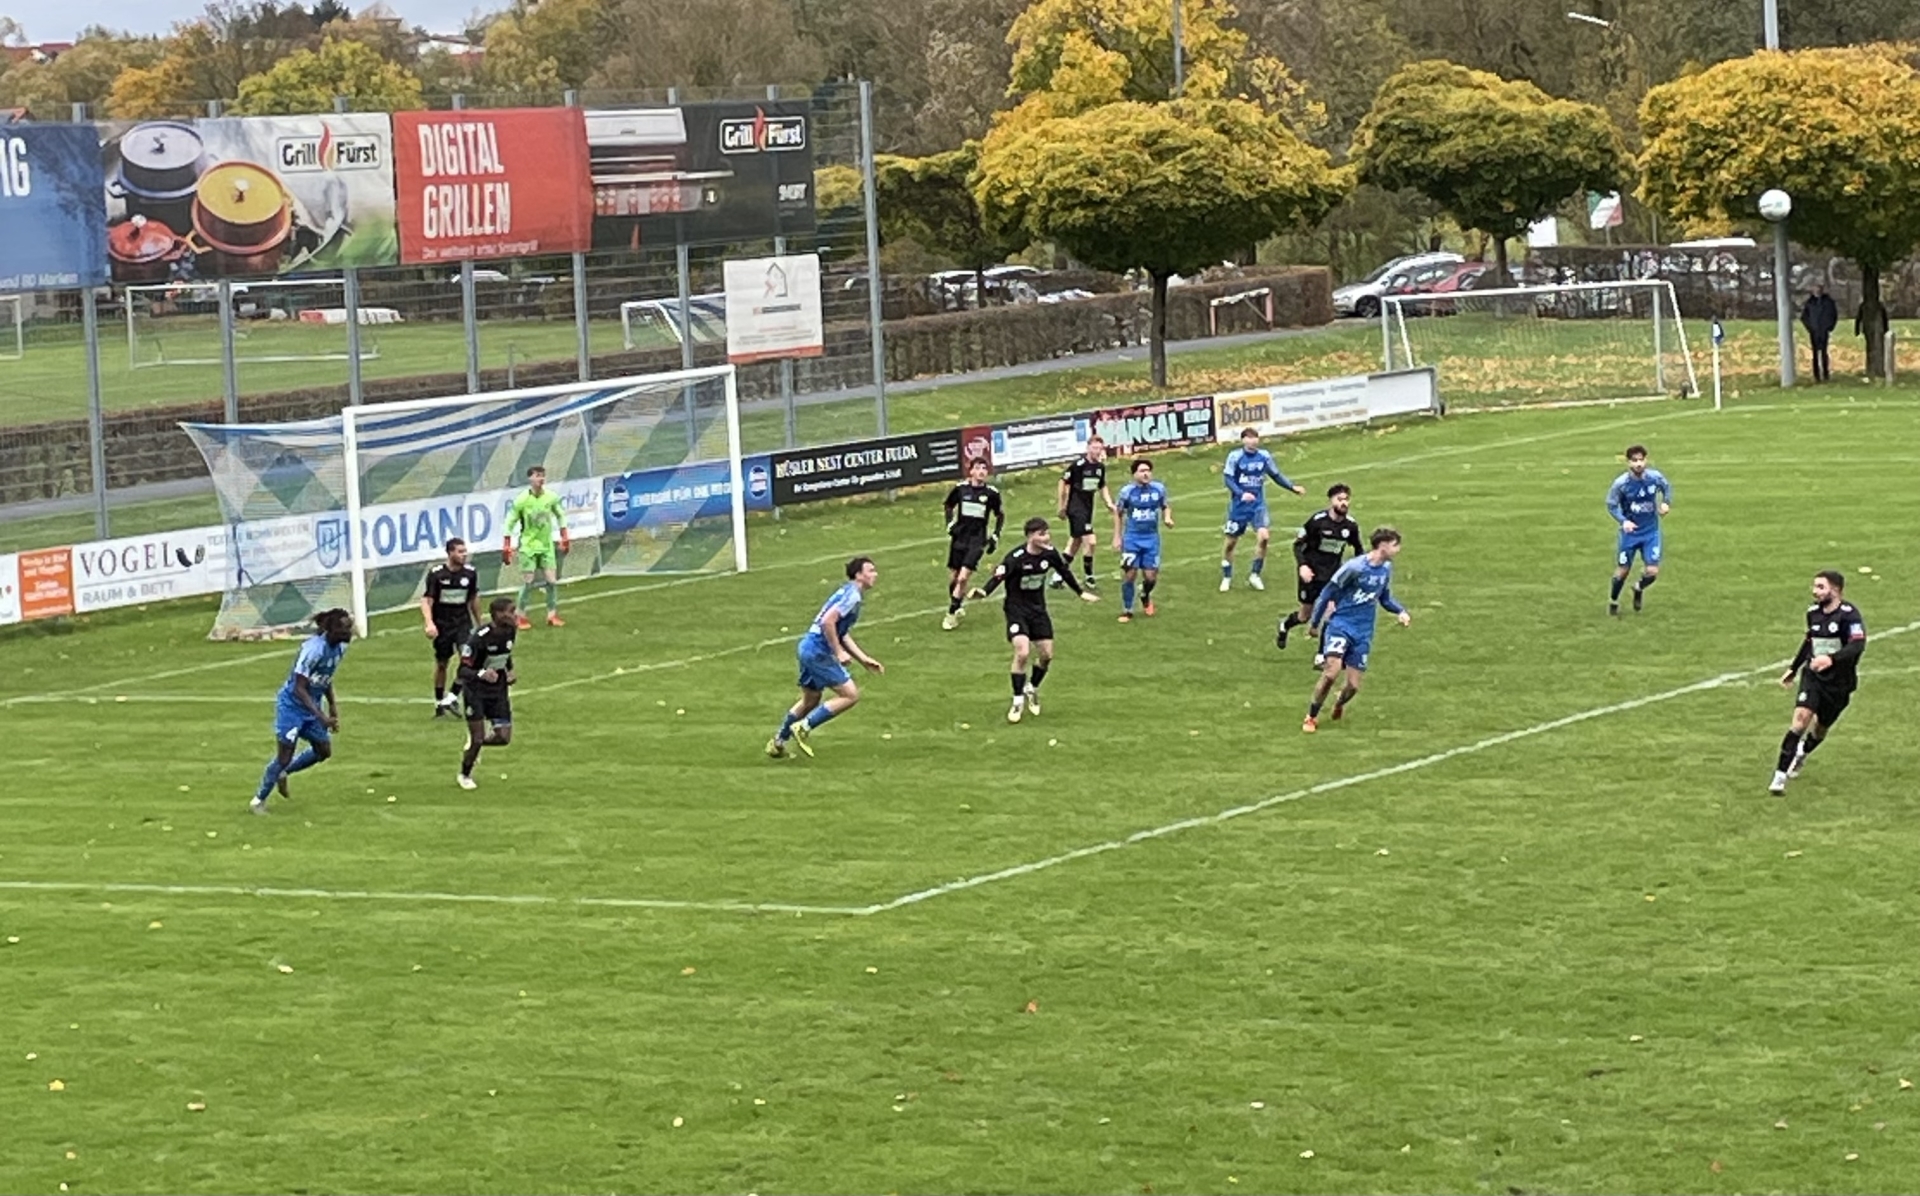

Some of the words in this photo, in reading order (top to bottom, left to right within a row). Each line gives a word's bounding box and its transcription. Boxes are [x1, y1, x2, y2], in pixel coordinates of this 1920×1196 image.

[417, 122, 504, 177] DIGITAL
[725, 124, 754, 148] Grill
[282, 142, 317, 167] Grill
[336, 141, 378, 164] Fürst
[423, 182, 511, 239] GRILLEN
[1220, 400, 1270, 427] Böhm
[80, 541, 175, 578] VOGEL
[83, 587, 123, 604] RAUM
[128, 585, 136, 599] &
[141, 580, 175, 597] BETT
